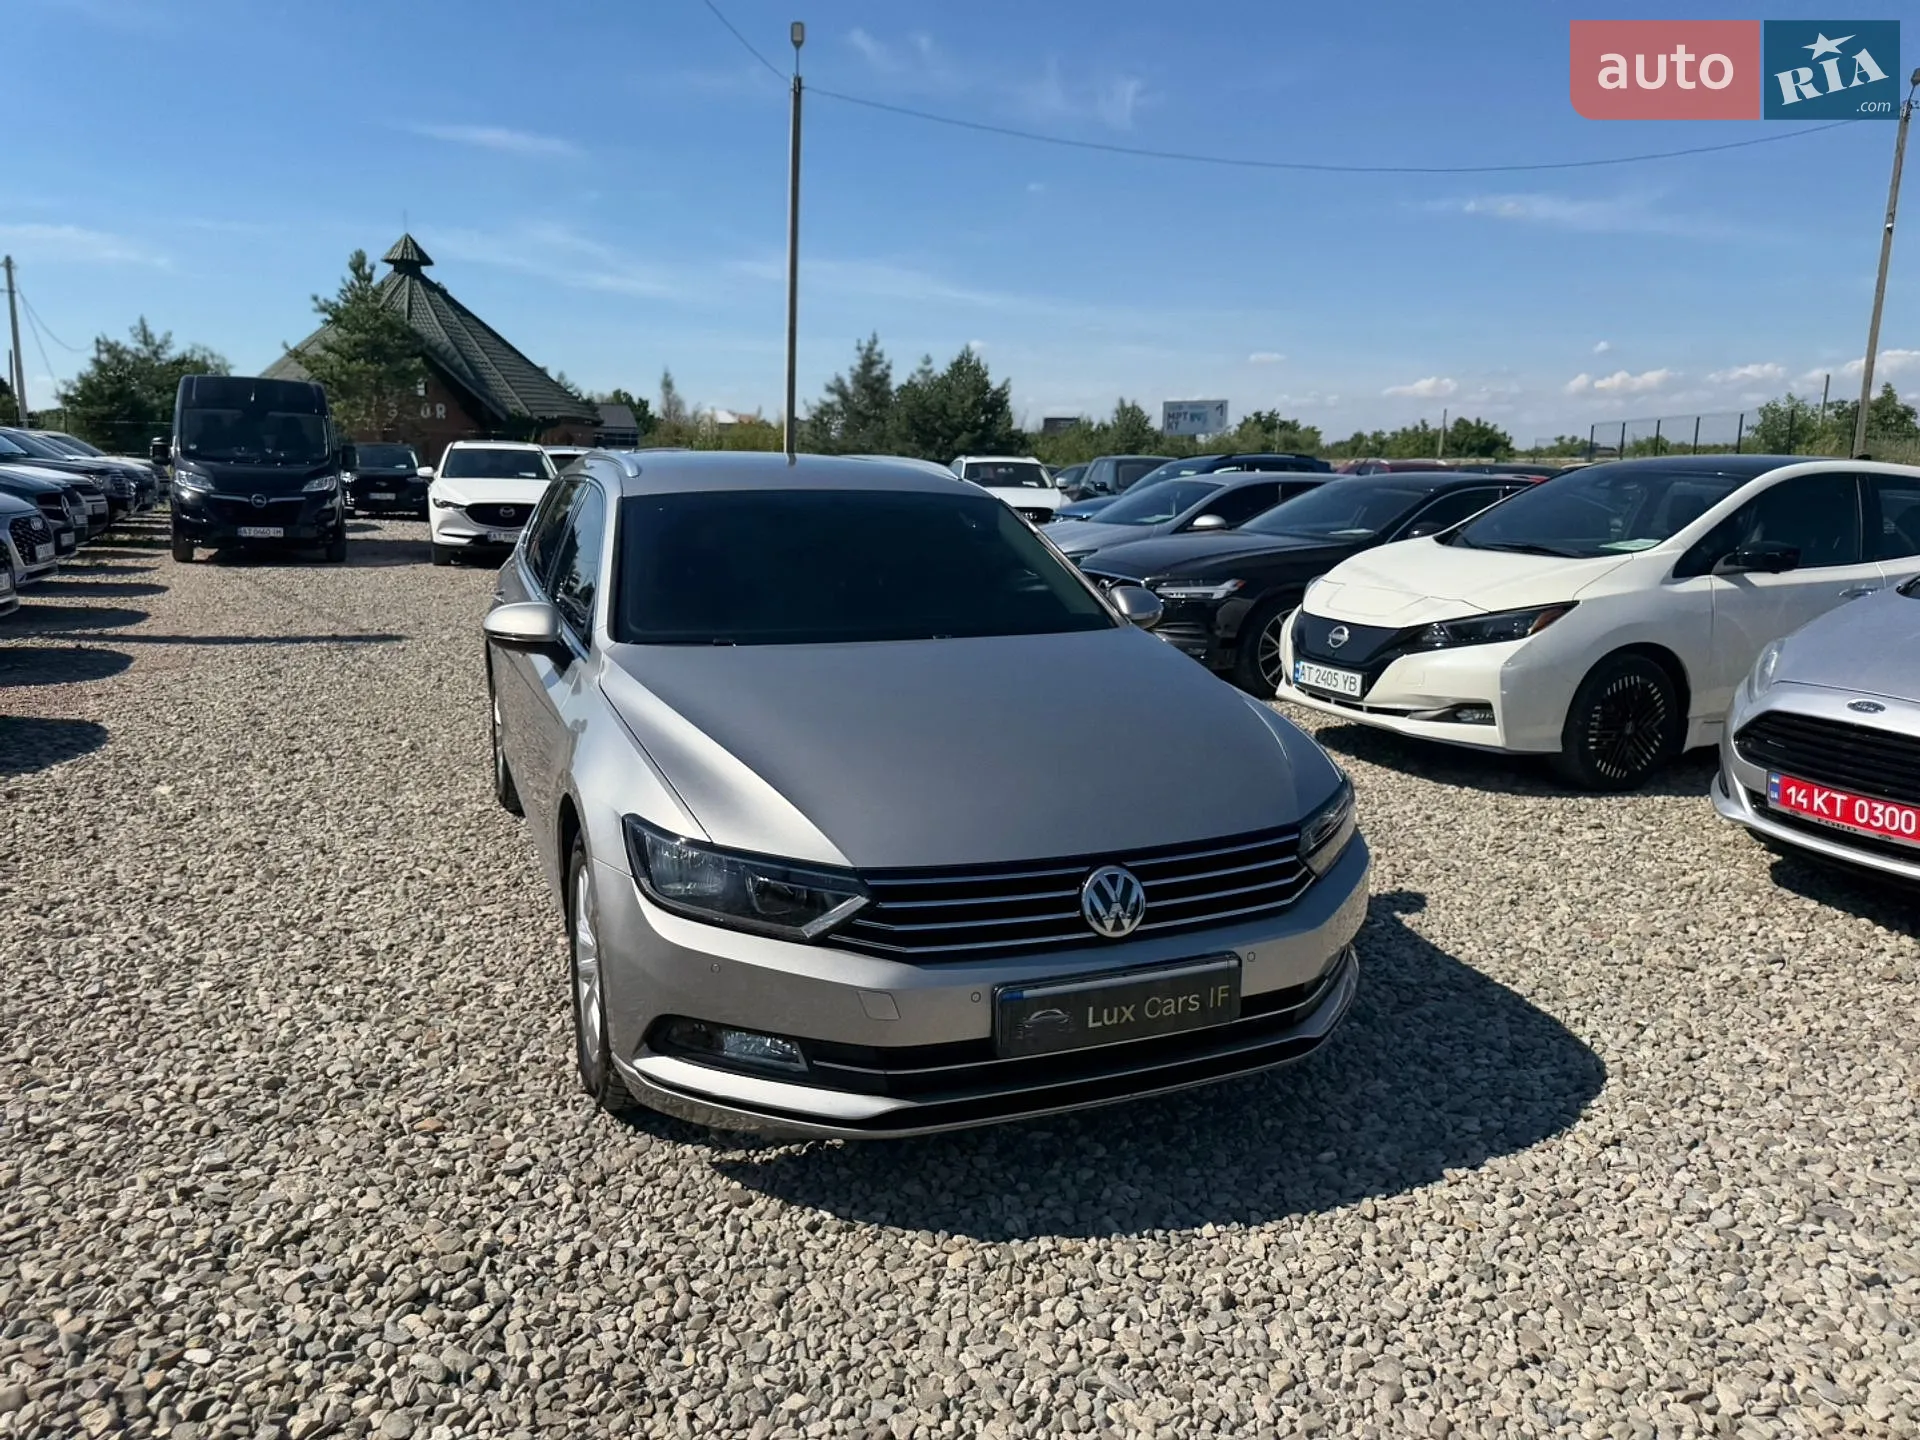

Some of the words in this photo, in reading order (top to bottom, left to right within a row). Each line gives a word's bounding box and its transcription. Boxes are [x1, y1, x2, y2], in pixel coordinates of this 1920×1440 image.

[1300, 664, 1314, 682] AT
[1315, 668, 1339, 689] 2405
[1342, 673, 1358, 692] YB
[1854, 799, 1916, 834] 0300
[1088, 1003, 1137, 1028] Lux
[1144, 993, 1200, 1019] Cars
[1209, 985, 1230, 1008] IF
